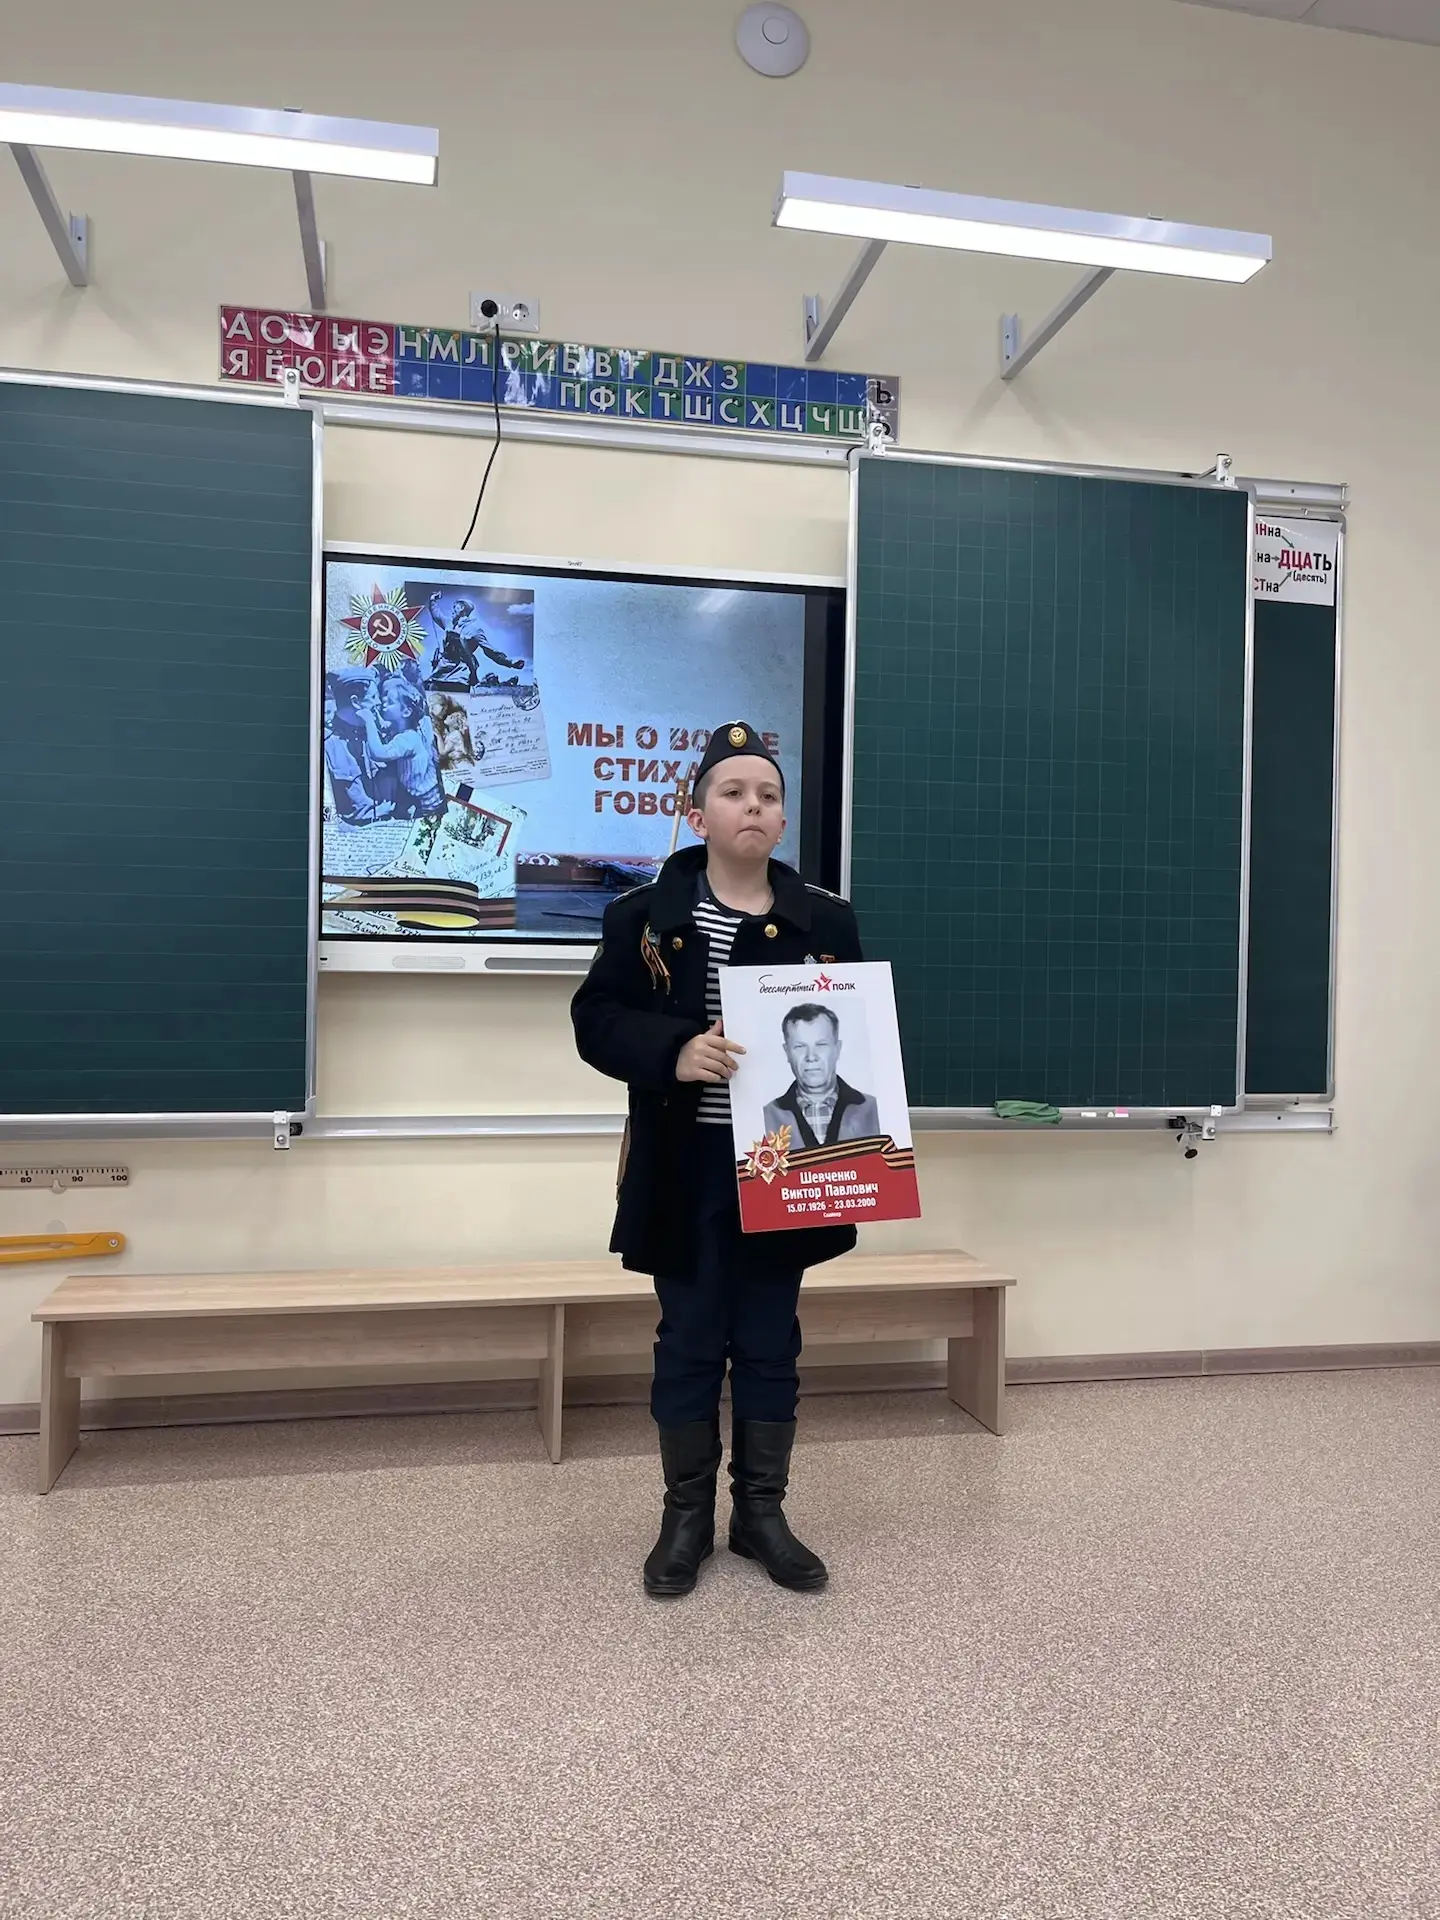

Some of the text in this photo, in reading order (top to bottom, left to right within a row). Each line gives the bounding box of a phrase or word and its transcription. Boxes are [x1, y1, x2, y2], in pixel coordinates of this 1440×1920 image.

[1255, 523, 1281, 537] Нна
[1278, 549, 1332, 571] ДЦАТЬ
[567, 722, 624, 748] МЫ
[635, 725, 658, 750] О
[670, 727, 780, 755] ВОЕ
[110, 1174, 128, 1182] 100
[800, 1170, 857, 1185] Шевченко
[781, 1183, 878, 1200] Виктор Павлович
[786, 1201, 826, 1213] 15.07.1926
[834, 1198, 876, 1210] 23.03.2000
